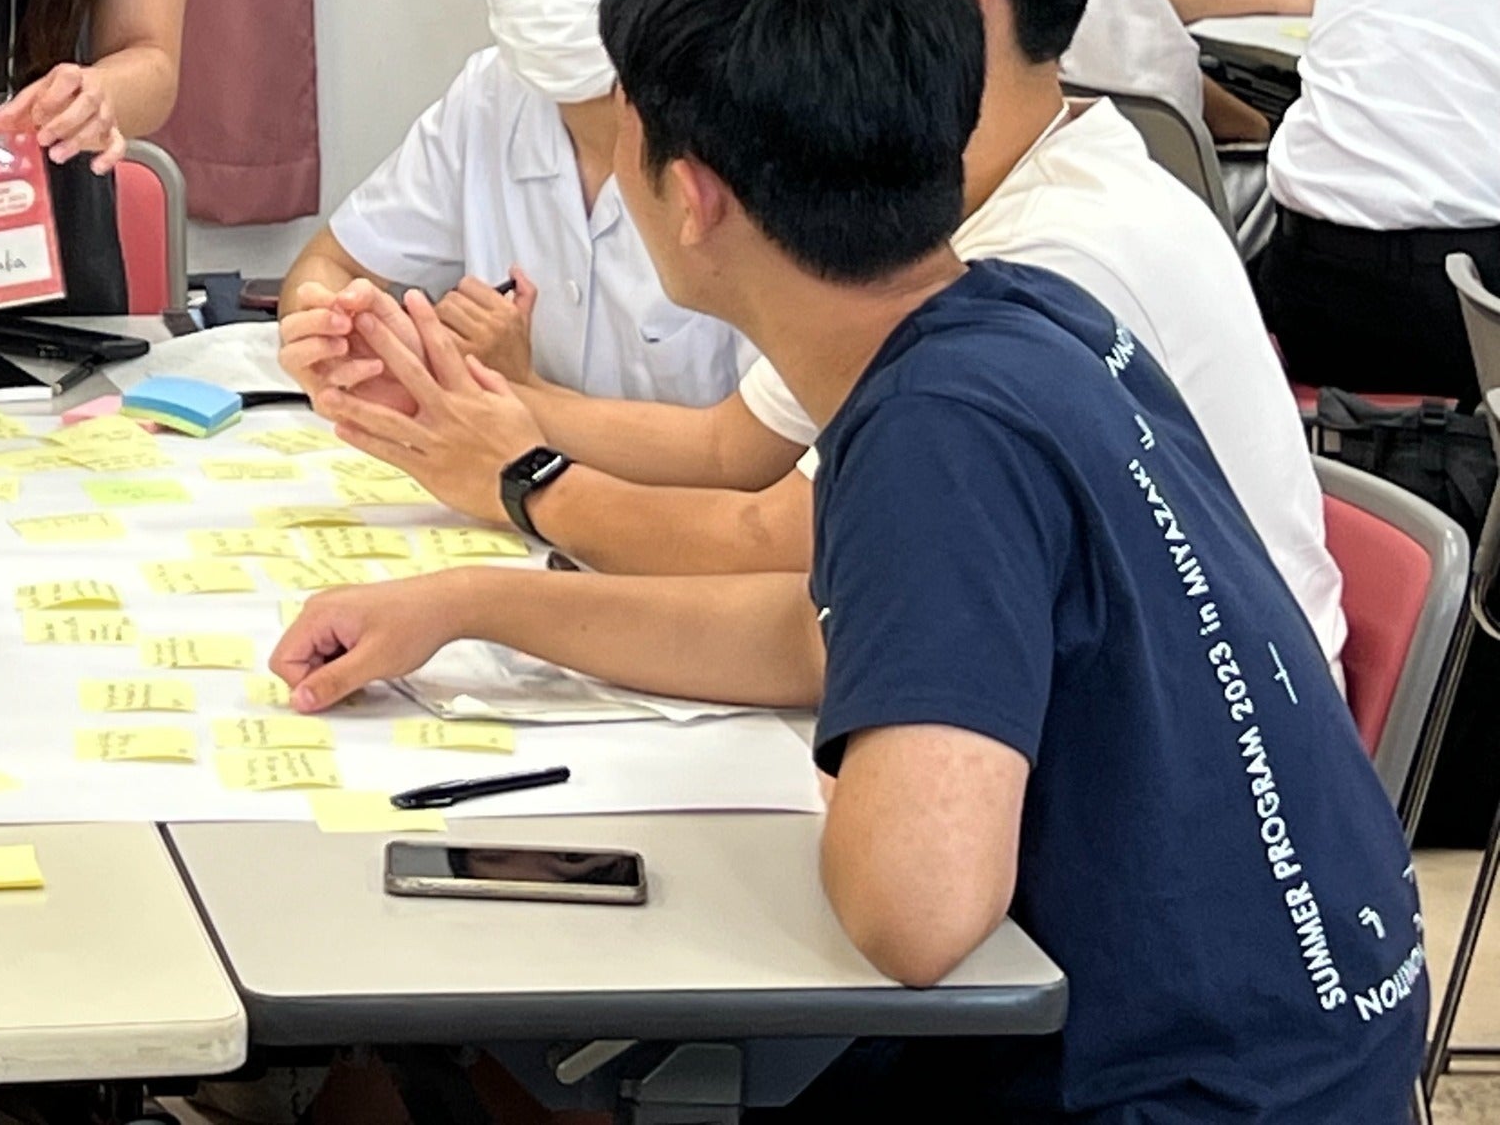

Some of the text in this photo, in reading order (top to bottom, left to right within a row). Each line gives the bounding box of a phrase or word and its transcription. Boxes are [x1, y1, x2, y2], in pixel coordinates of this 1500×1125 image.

[1128, 458, 1348, 1011] SUMMER PROGRAM 2023 in MIYAZAKI
